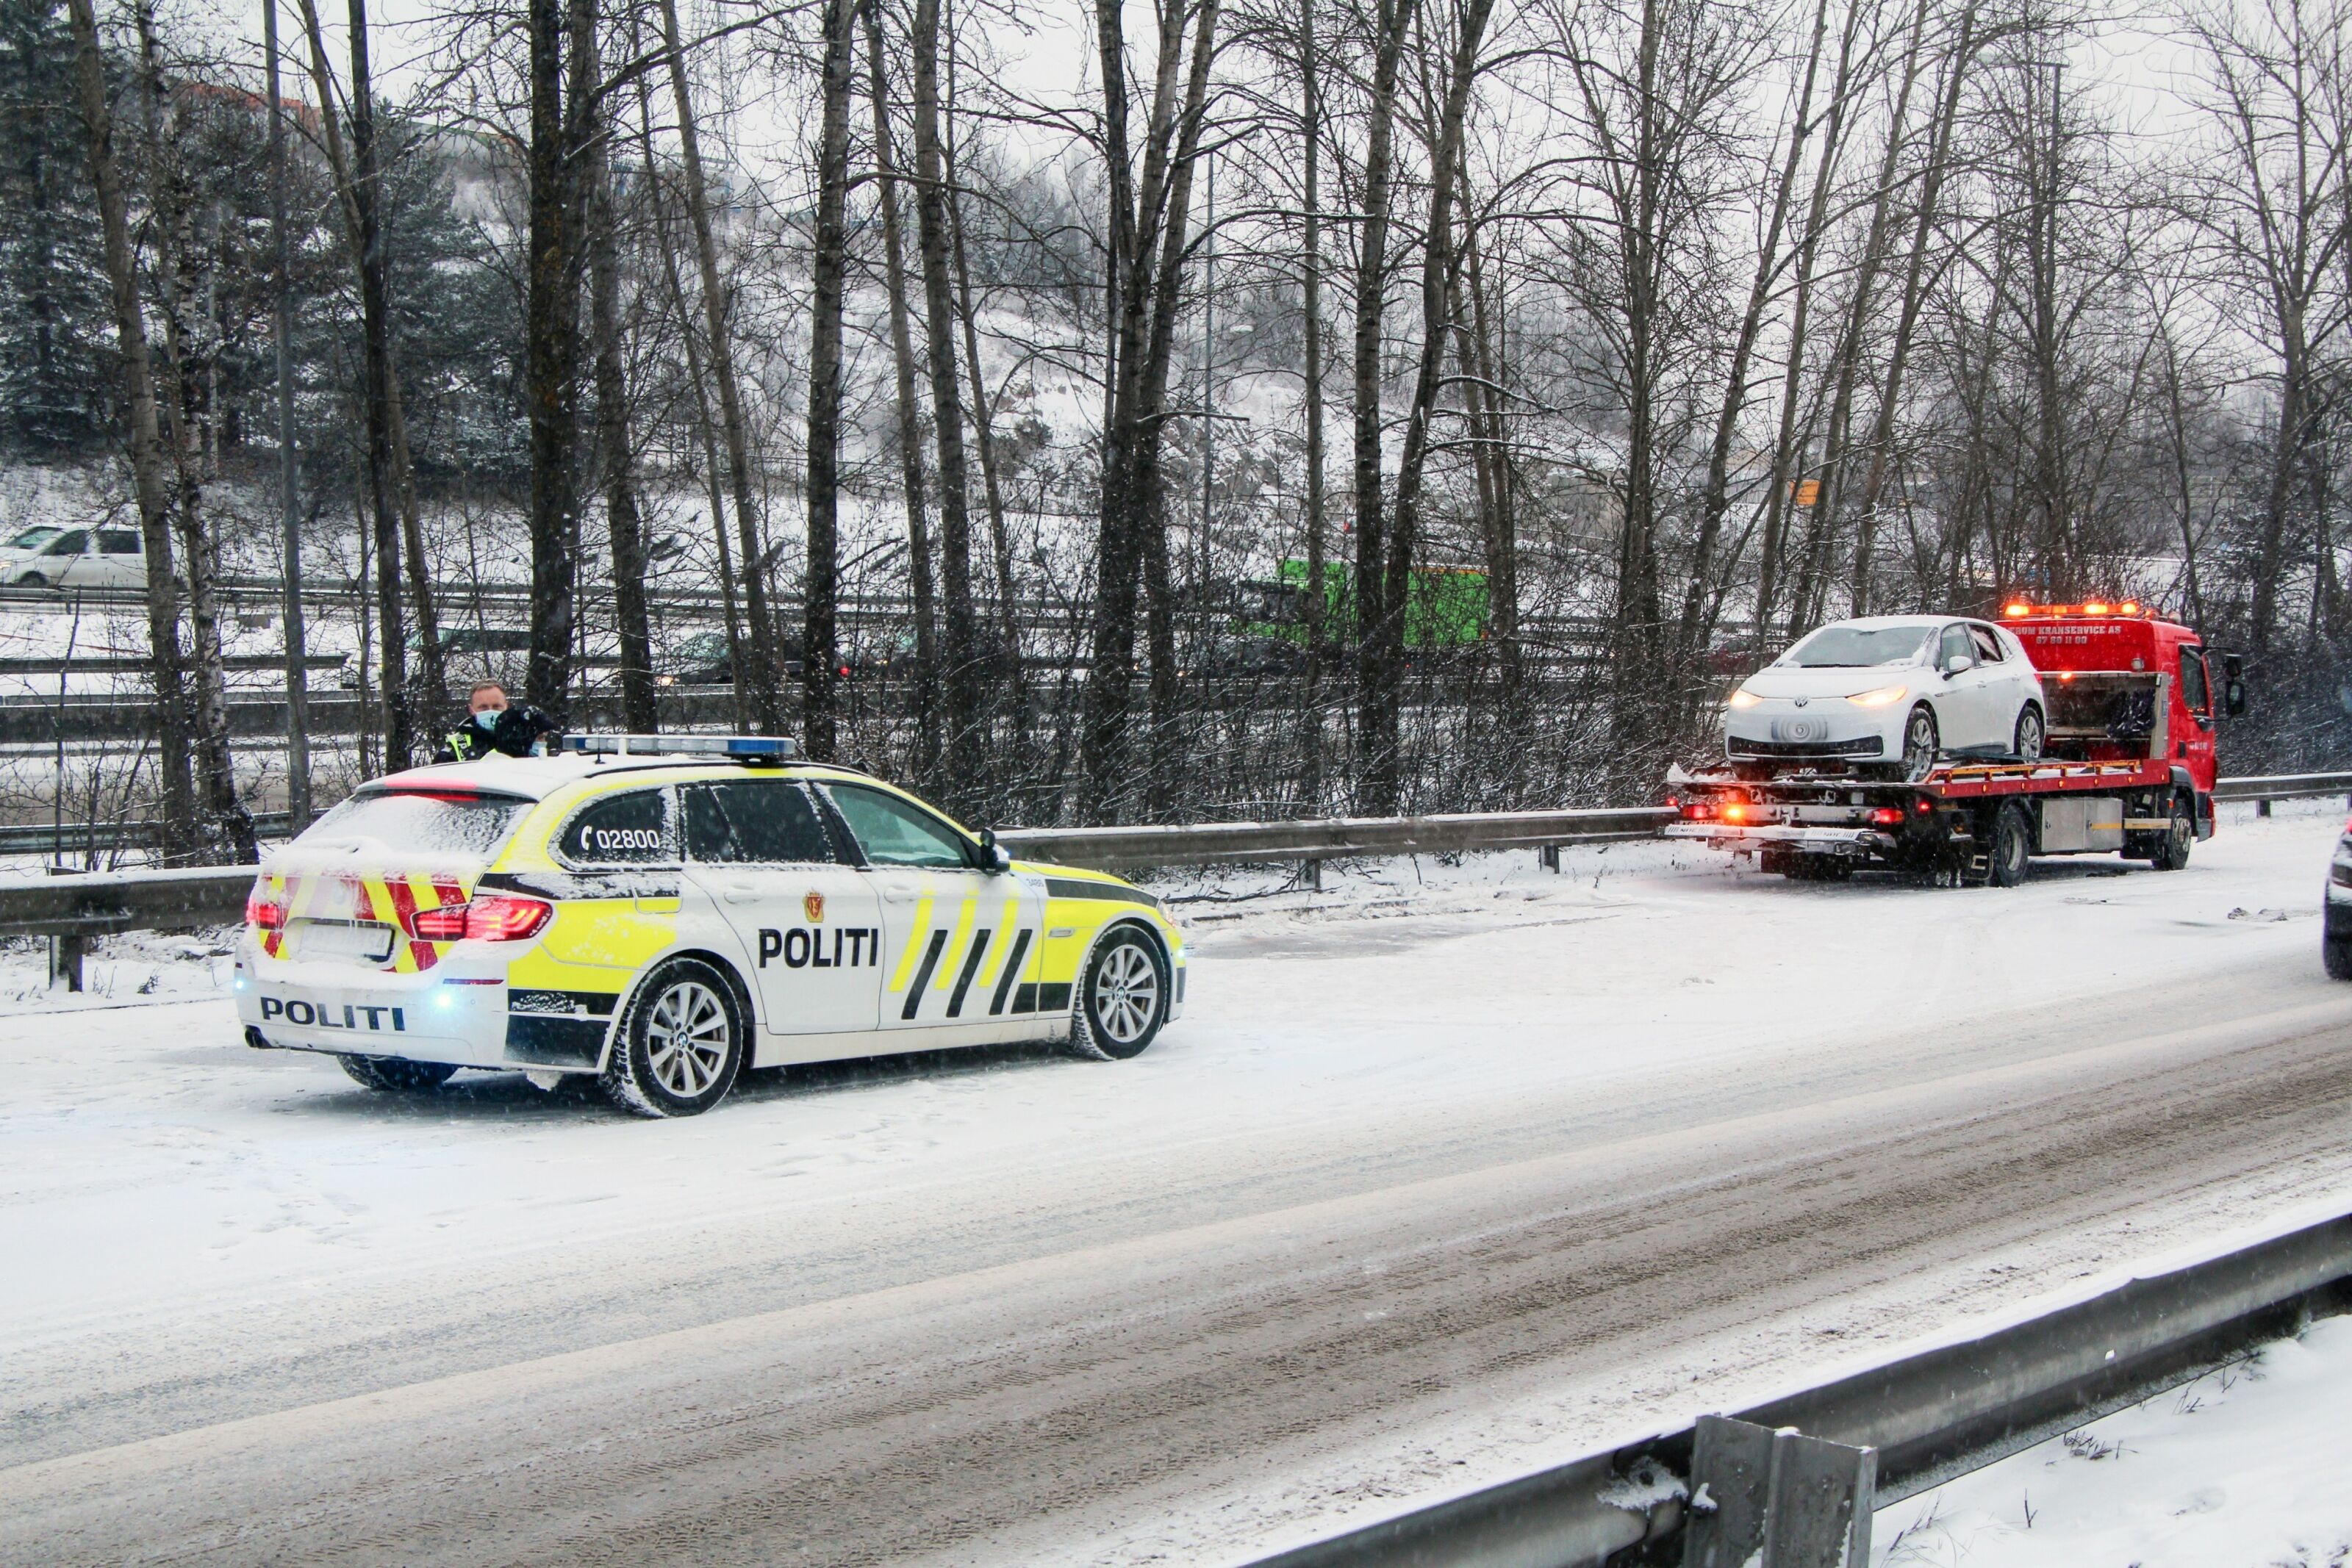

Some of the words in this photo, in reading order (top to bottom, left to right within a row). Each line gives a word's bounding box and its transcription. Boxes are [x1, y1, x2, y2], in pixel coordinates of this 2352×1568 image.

[2038, 625, 2106, 635] KRANSERVICE
[2108, 625, 2121, 634] AS
[596, 829, 660, 849] 02800
[759, 927, 878, 968] POLITI
[259, 996, 406, 1032] POLITI
